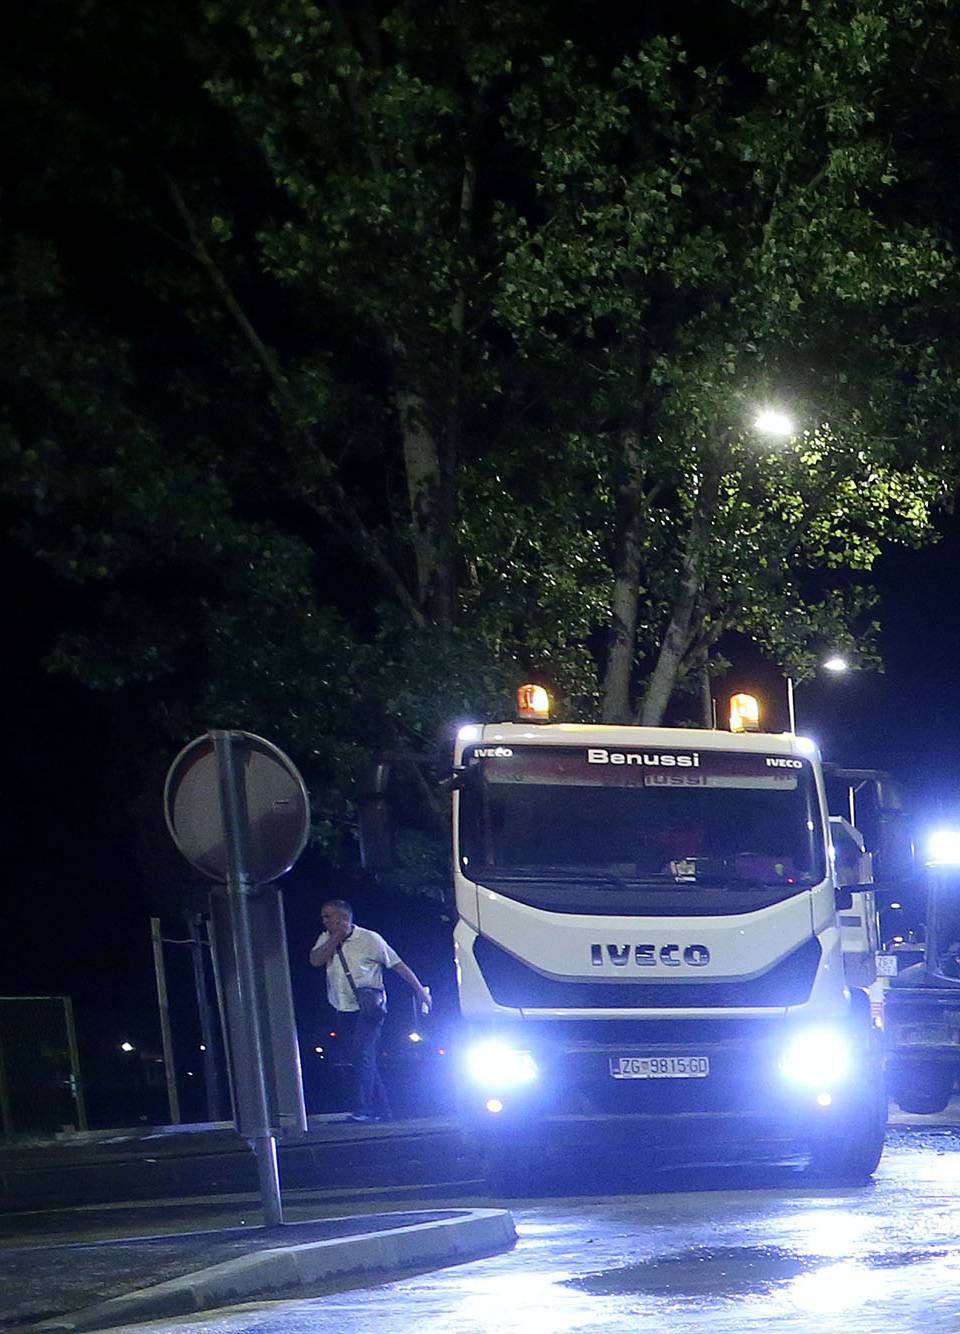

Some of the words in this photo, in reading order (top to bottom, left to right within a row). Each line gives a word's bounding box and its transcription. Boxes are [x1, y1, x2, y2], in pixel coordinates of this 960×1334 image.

[474, 747, 513, 758] IVECO
[588, 749, 699, 767] Benussi
[766, 758, 803, 768] IVECO
[591, 944, 710, 966] IVECO
[621, 1059, 640, 1073] ZG
